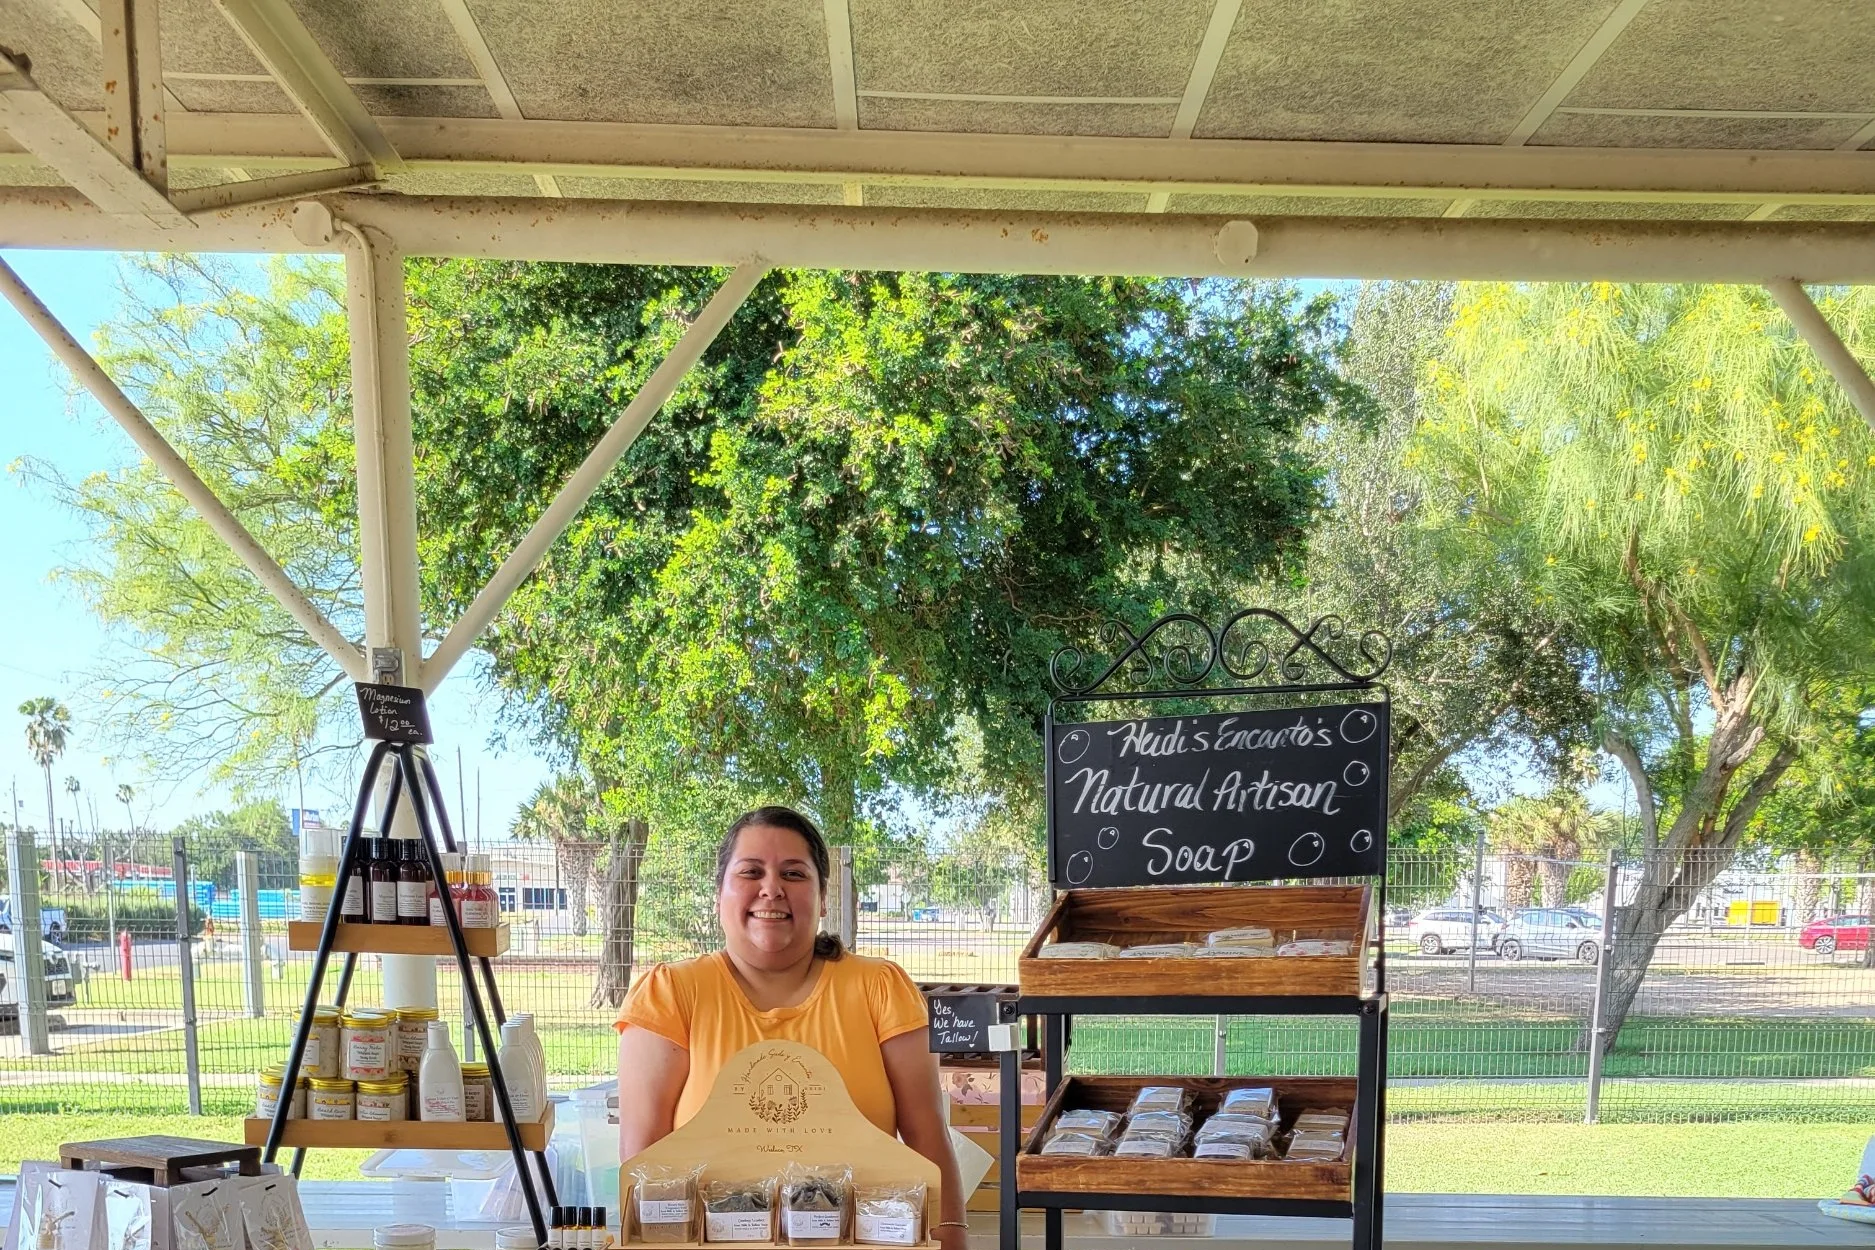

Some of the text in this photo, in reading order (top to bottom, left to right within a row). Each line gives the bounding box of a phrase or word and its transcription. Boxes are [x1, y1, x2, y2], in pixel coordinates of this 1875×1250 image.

[360, 687, 411, 704] Magnesium
[369, 702, 398, 714] Lotion
[1107, 716, 1333, 757] Heidi's Encanto's
[1065, 766, 1341, 816] Natural Artisan
[1142, 827, 1255, 880] Soap
[933, 999, 955, 1017] Yes,
[933, 1015, 976, 1028] We have
